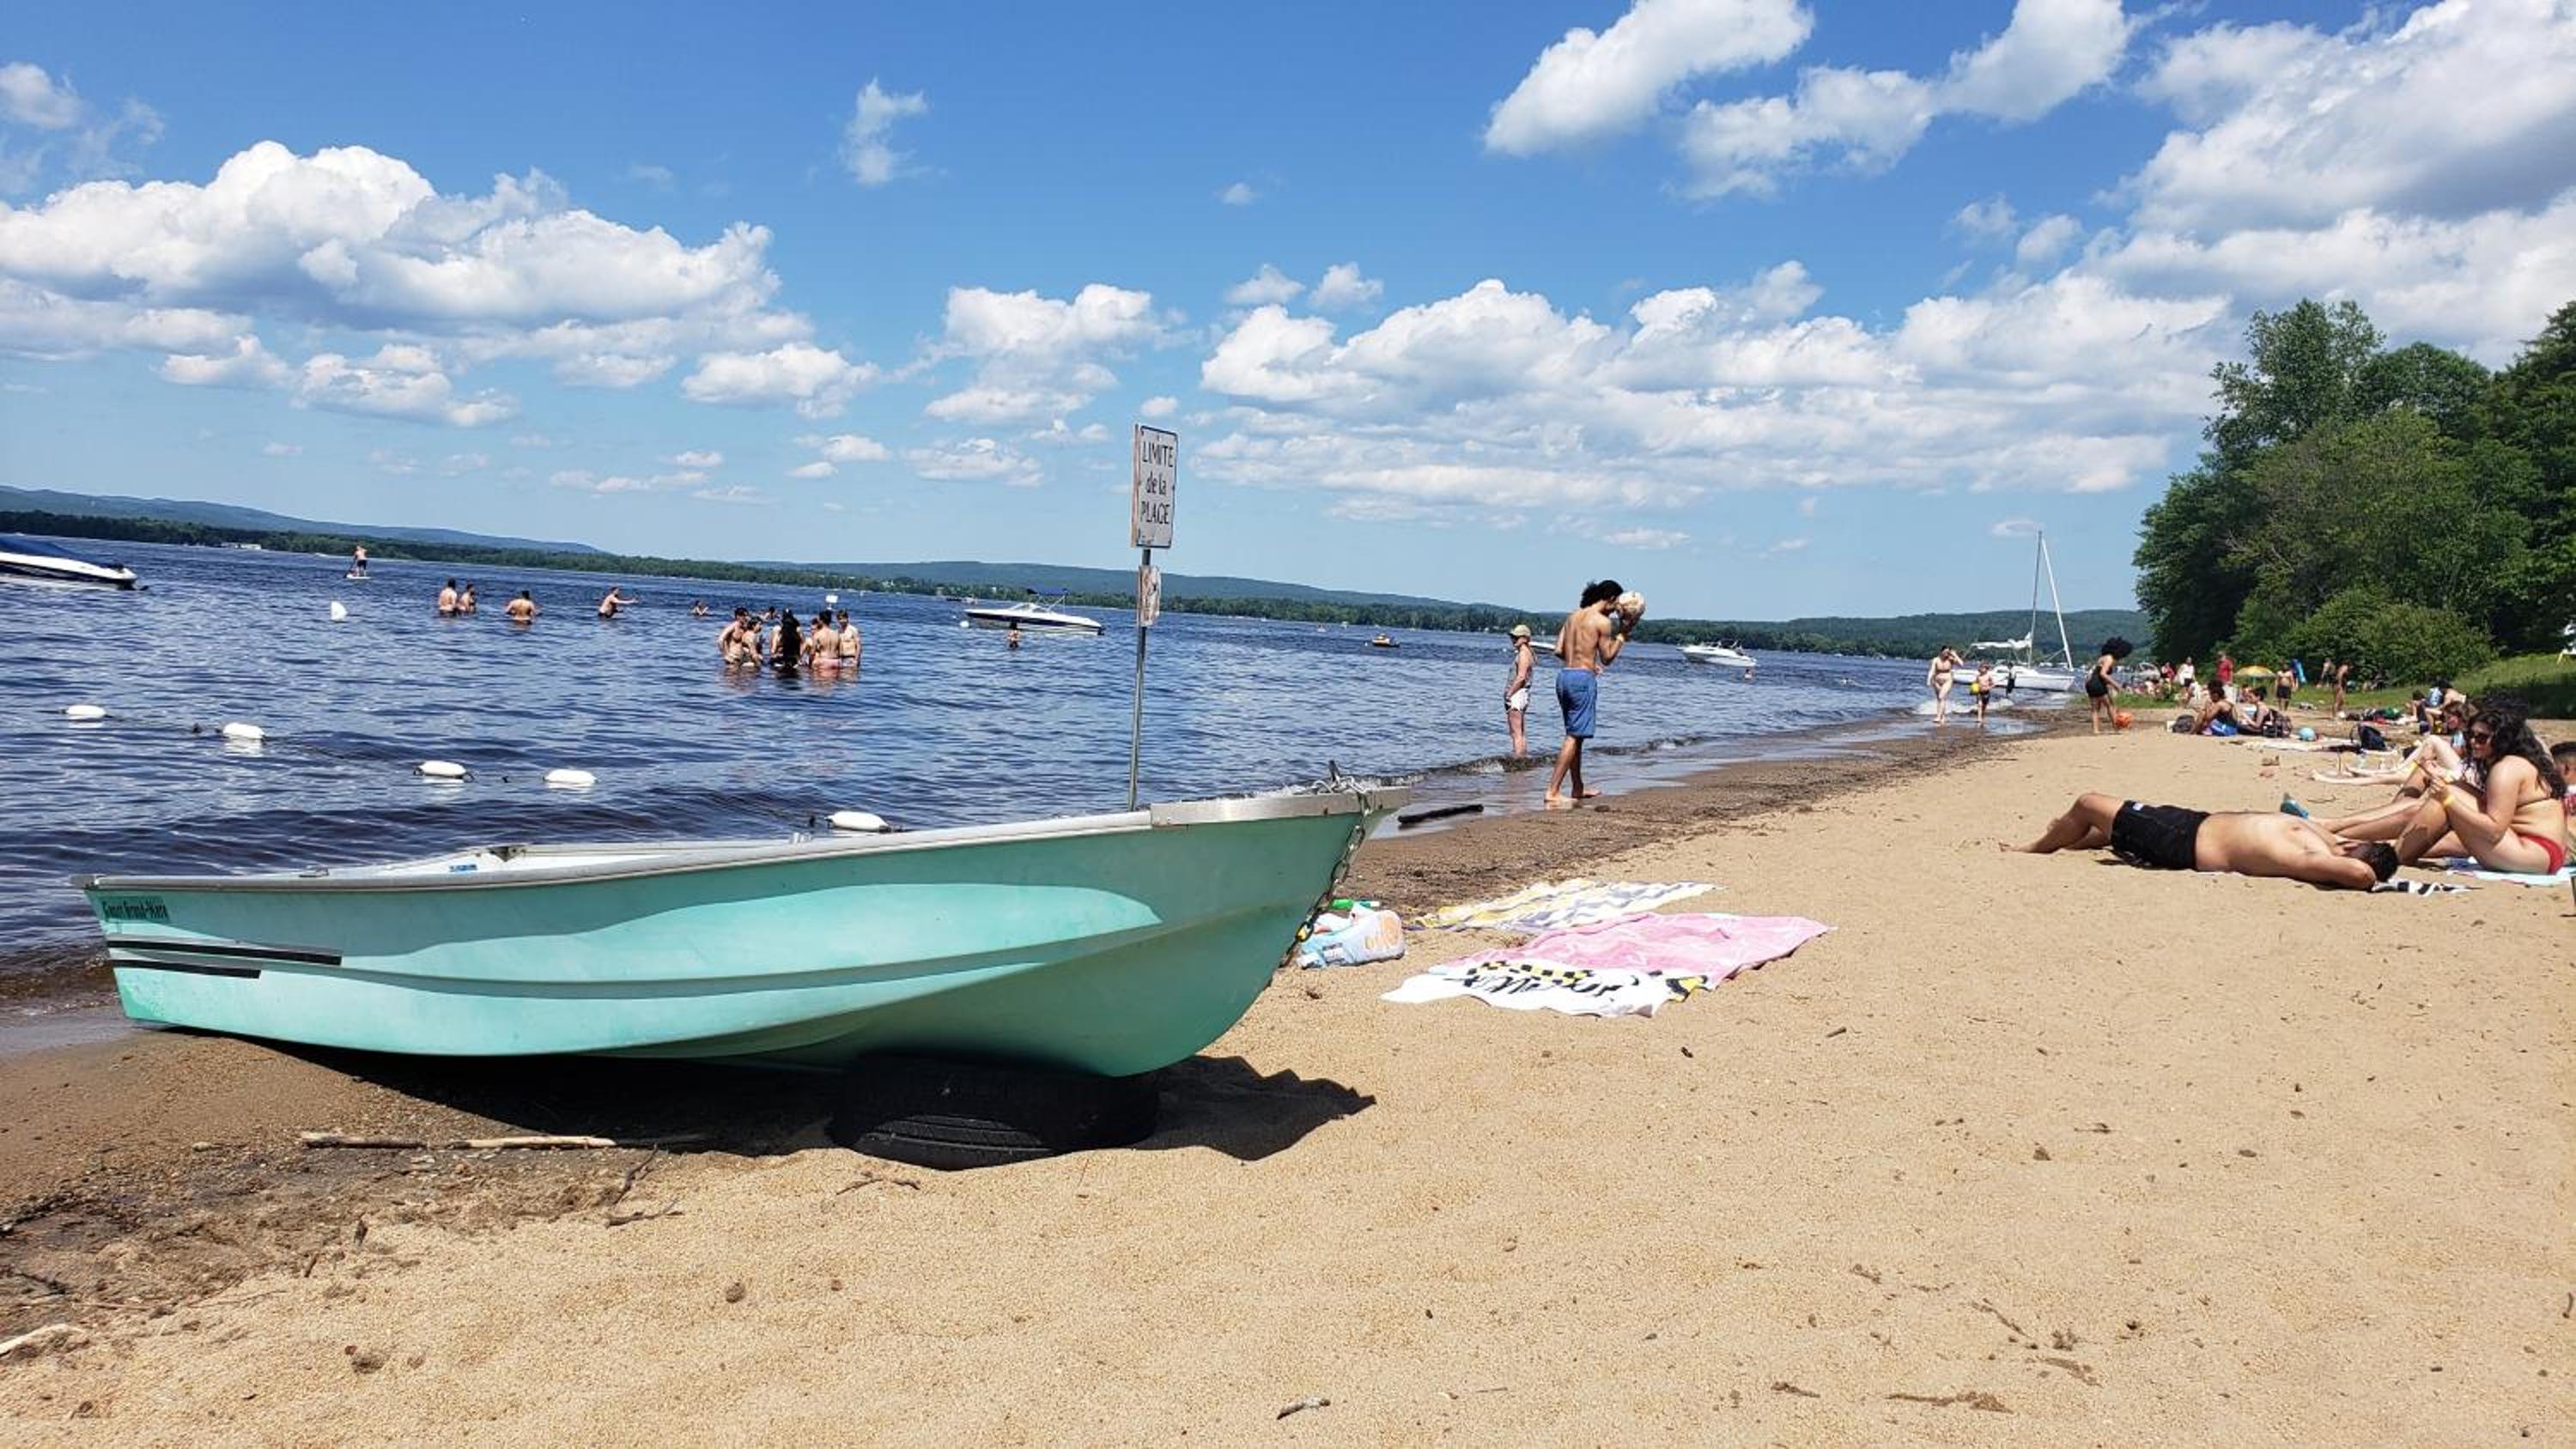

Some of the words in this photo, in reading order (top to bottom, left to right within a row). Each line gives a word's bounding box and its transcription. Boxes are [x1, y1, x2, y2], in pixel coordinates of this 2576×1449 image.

[1142, 440, 1174, 468] LIMITE
[1145, 470, 1157, 494] de
[1158, 473, 1167, 495] la
[1140, 500, 1170, 524] PLAGE
